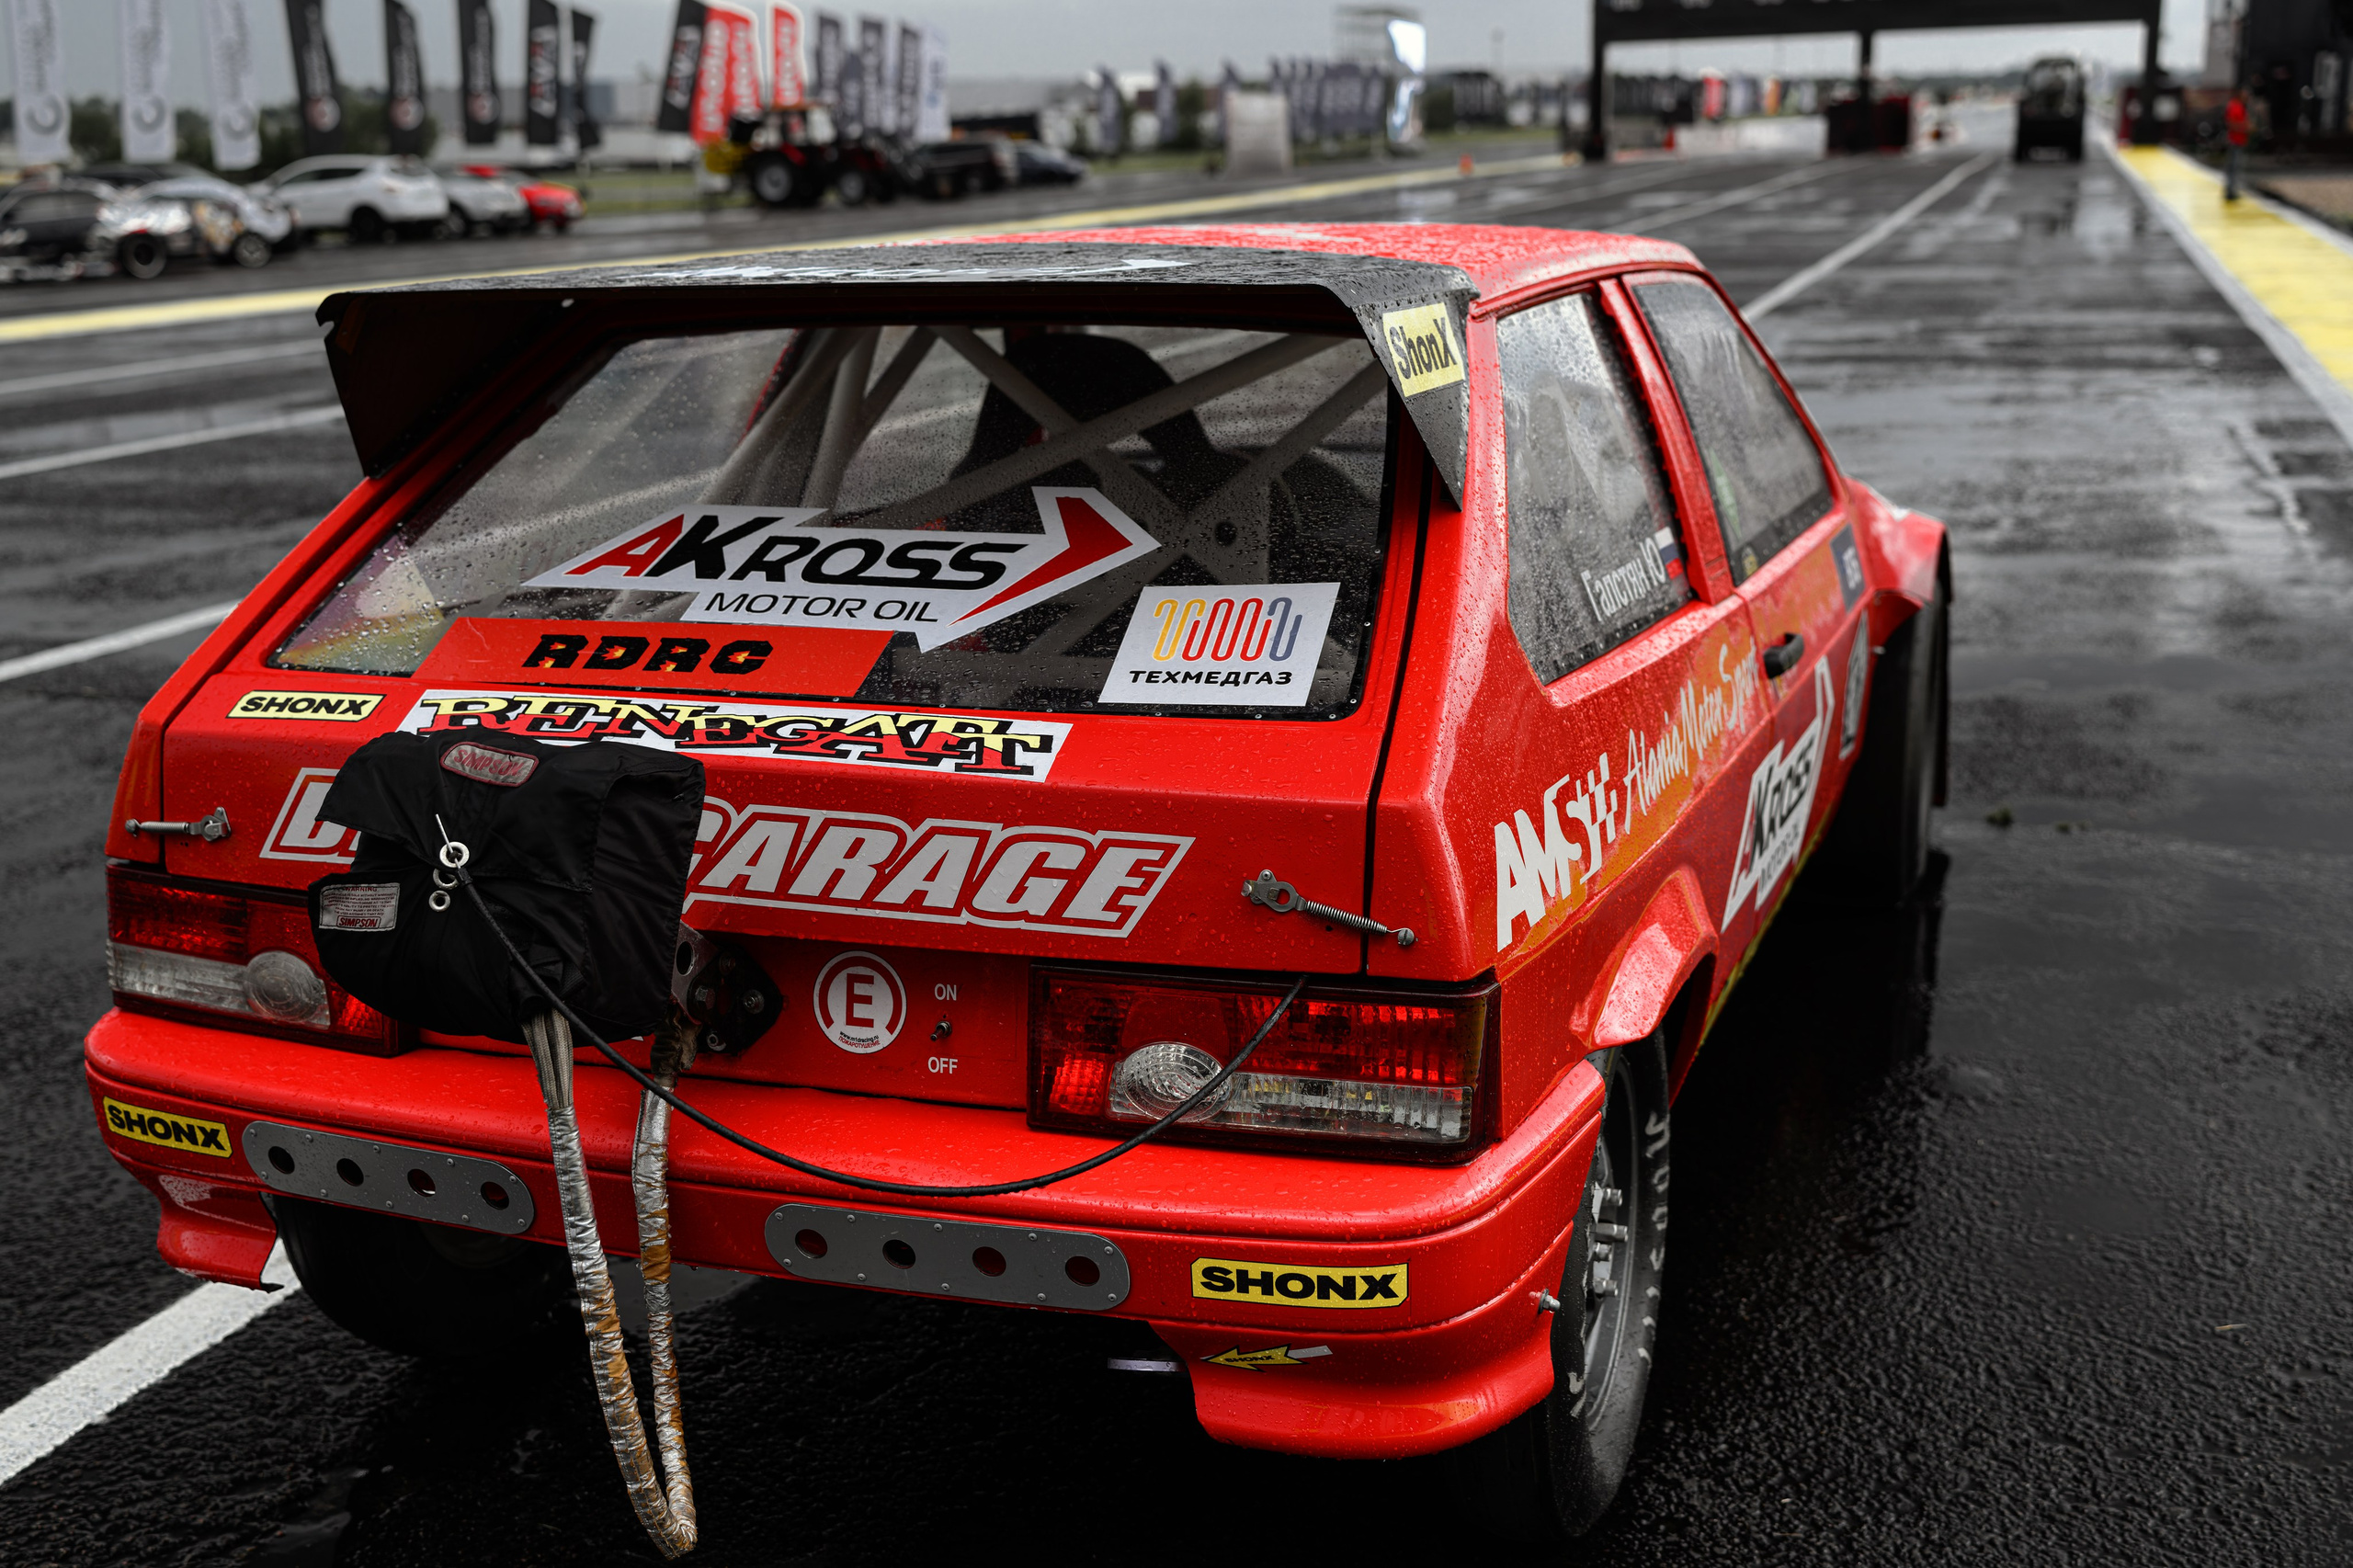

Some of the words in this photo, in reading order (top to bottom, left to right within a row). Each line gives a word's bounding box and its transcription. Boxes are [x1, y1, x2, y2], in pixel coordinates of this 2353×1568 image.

[1389, 317, 1457, 380] ShonX
[563, 513, 1031, 591] AKROSS
[704, 592, 868, 619] MOTOR
[873, 600, 938, 622] OIL
[521, 634, 774, 675] RDRC
[1129, 670, 1293, 687] ТЕХМЕДГАЗ
[240, 697, 372, 716] SHONX
[453, 749, 525, 777] SIMPSON
[338, 917, 379, 927] SIMPSON
[846, 972, 875, 1028] E
[934, 983, 957, 1001] ON
[927, 1057, 959, 1074] OFF
[108, 1105, 228, 1152] SHONX
[1199, 1266, 1400, 1301] SHONX
